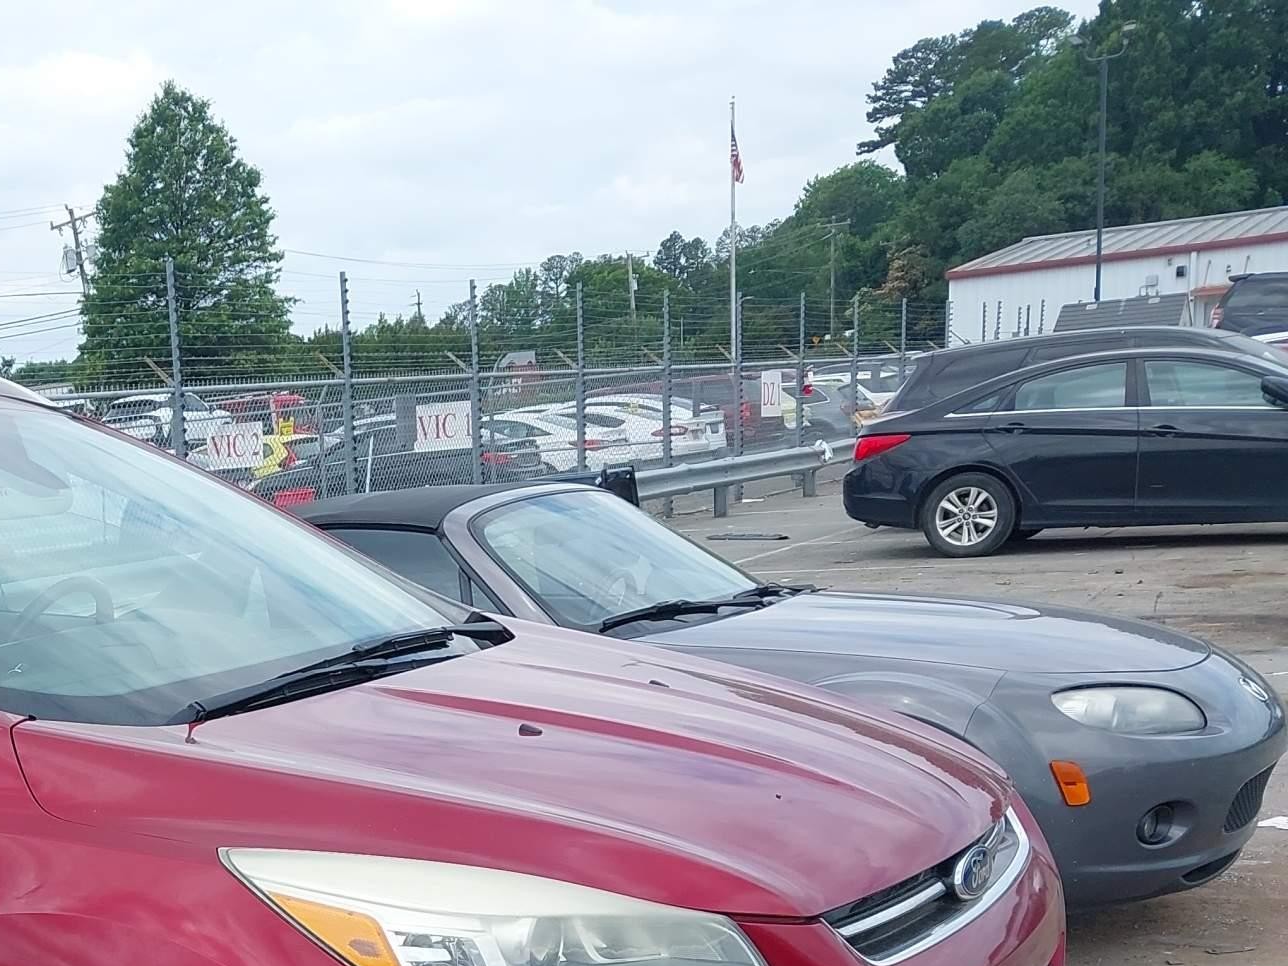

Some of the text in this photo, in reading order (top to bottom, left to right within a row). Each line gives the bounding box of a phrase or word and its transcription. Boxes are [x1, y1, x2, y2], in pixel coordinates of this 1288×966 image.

[418, 412, 472, 440] VIC 1
[211, 432, 260, 458] VIC 2
